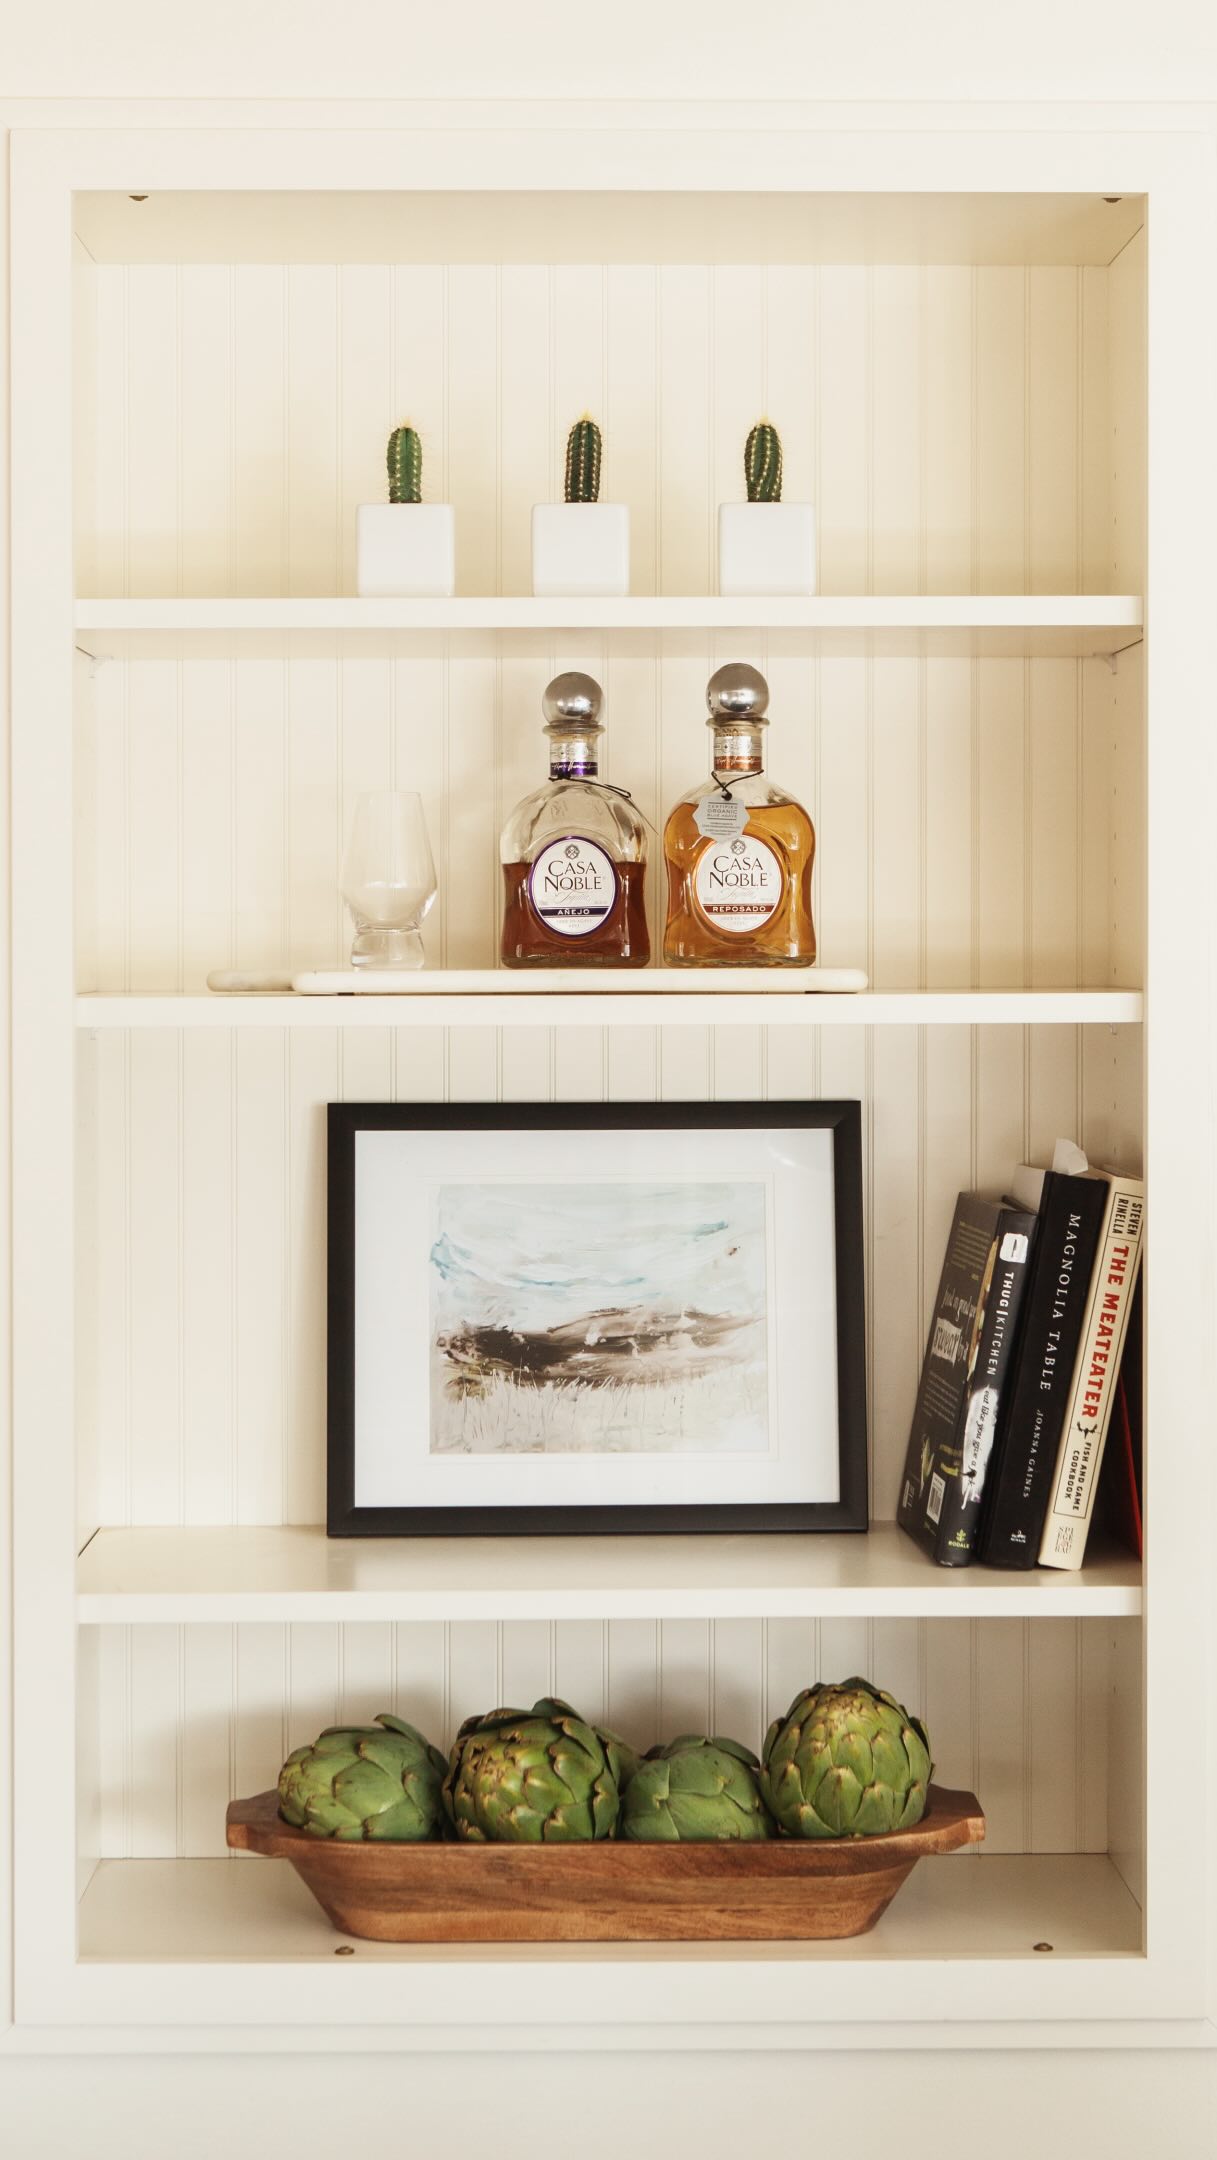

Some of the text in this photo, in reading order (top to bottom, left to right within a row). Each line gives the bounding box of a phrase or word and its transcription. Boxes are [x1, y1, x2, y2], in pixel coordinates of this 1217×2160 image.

[548, 860, 597, 876] CASA
[713, 856, 763, 873] CASA
[545, 876, 602, 892] NOBLE
[709, 872, 768, 888] NOBLE
[1112, 1198, 1129, 1235] RINELLA
[1126, 1202, 1143, 1236] STEVEN
[1040, 1213, 1081, 1390] MAGNOLIA TABLE
[987, 1272, 1014, 1376] THUG KITCHEN
[1082, 1246, 1130, 1418] THE MEATEATER
[980, 1405, 990, 1421] like
[976, 1420, 984, 1440] you
[972, 1440, 980, 1459] give
[1023, 1409, 1044, 1499] JOANNA GAINES
[1064, 1450, 1080, 1500] COOKBOOK
[1072, 1441, 1092, 1511] FISH AND GAME
[948, 1540, 970, 1549] RODALE
